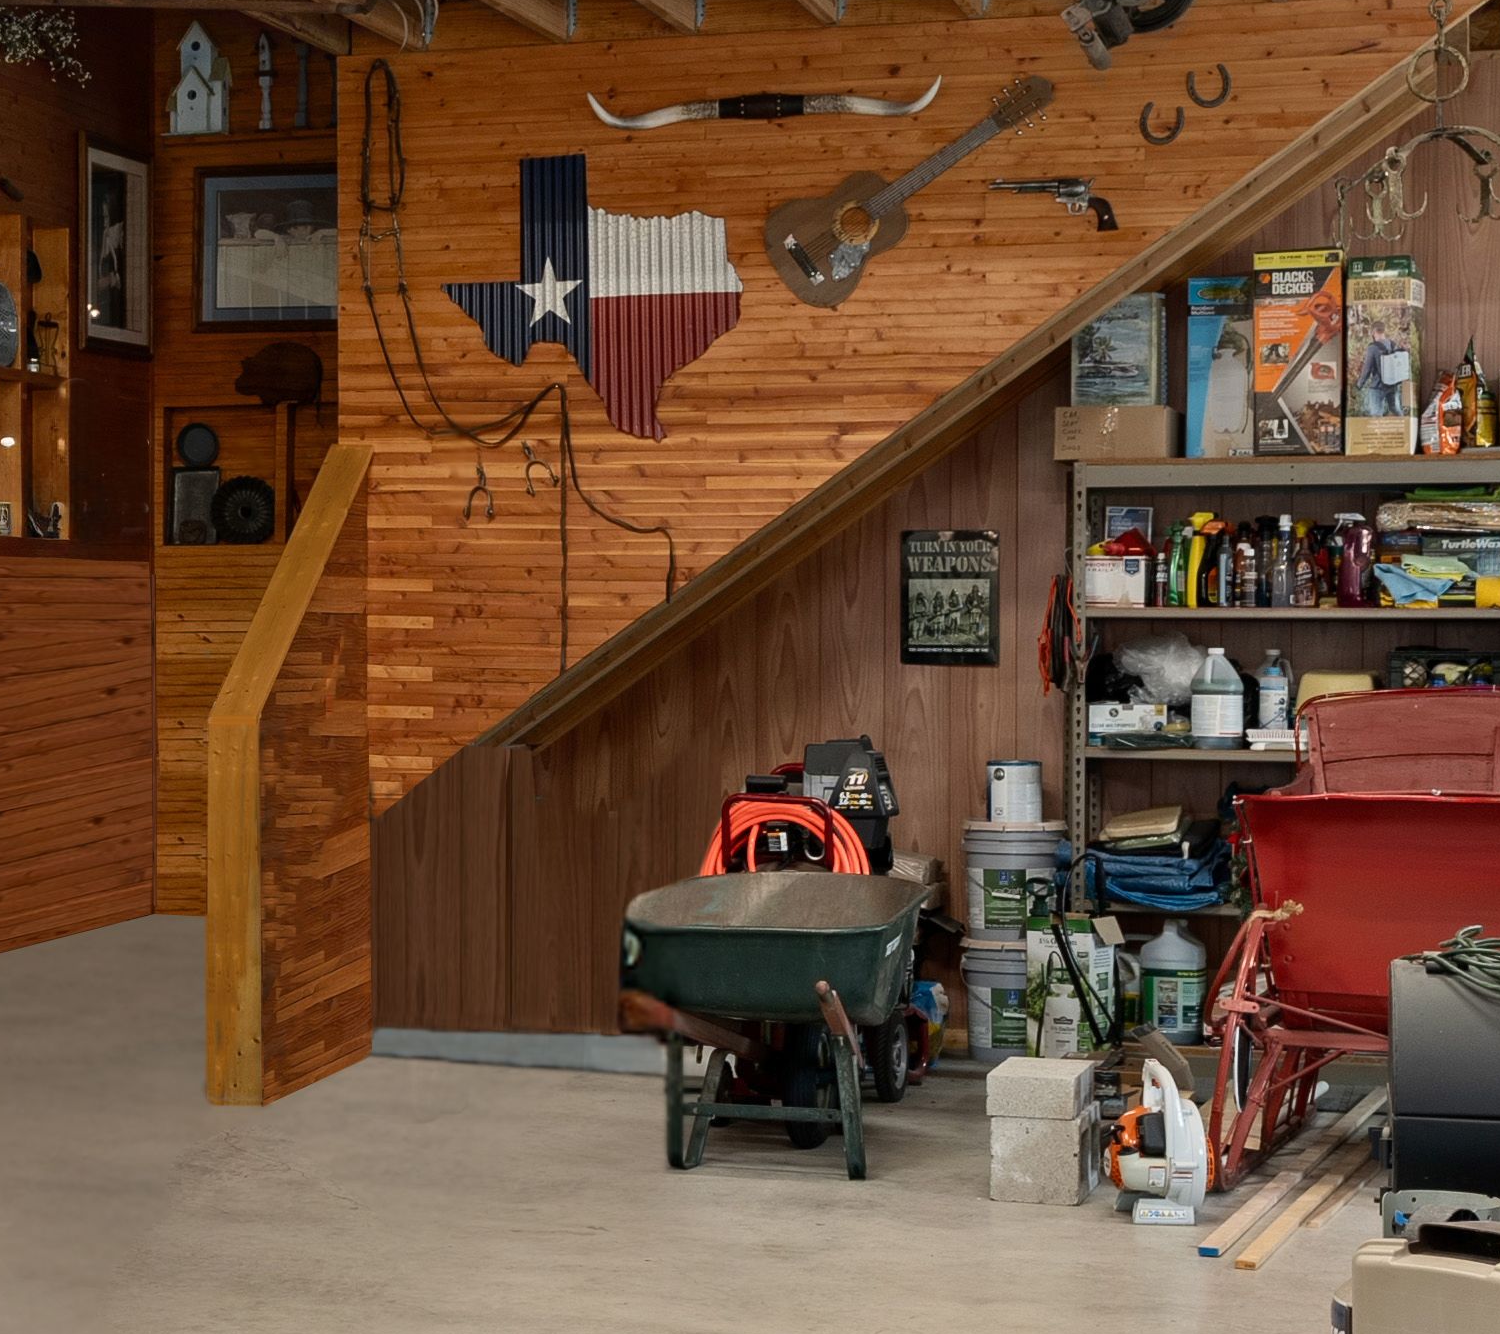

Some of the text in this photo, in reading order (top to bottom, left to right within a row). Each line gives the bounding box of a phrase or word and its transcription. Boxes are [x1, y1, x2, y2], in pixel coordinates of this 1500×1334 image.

[1272, 283, 1314, 295] DECKER
[909, 540, 991, 553] TURN IN YOUR
[907, 556, 991, 573] WEAPONS
[847, 773, 865, 785] 11
